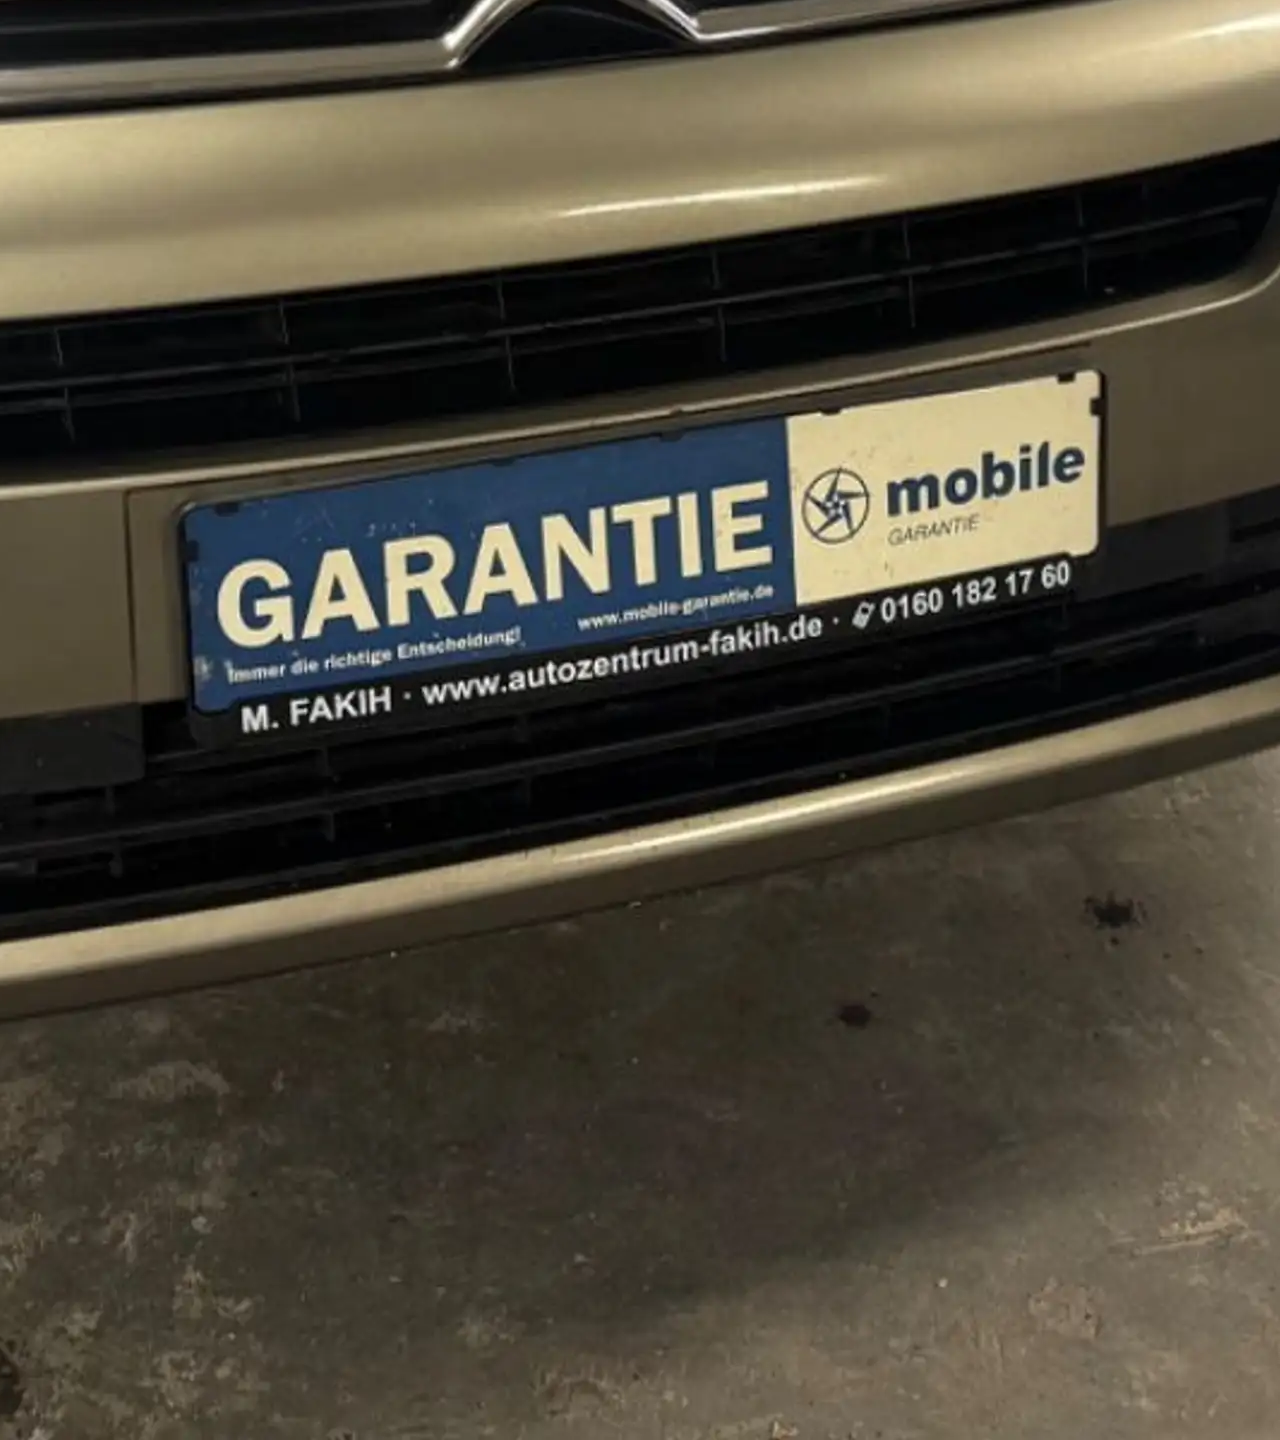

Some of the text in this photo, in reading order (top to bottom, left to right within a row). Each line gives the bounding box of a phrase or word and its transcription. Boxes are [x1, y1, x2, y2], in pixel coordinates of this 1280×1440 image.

[886, 441, 1086, 517] mobile
[887, 513, 981, 547] GARANTIE
[216, 480, 774, 648] GARANTIE
[577, 584, 775, 631] www.mobile-garantie.de
[227, 662, 286, 684] Immer
[289, 657, 319, 676] die
[323, 647, 392, 670] richtige
[240, 559, 1071, 734] M. FAKIH www.autozentrum-fakih.de 0160 182 17 60
